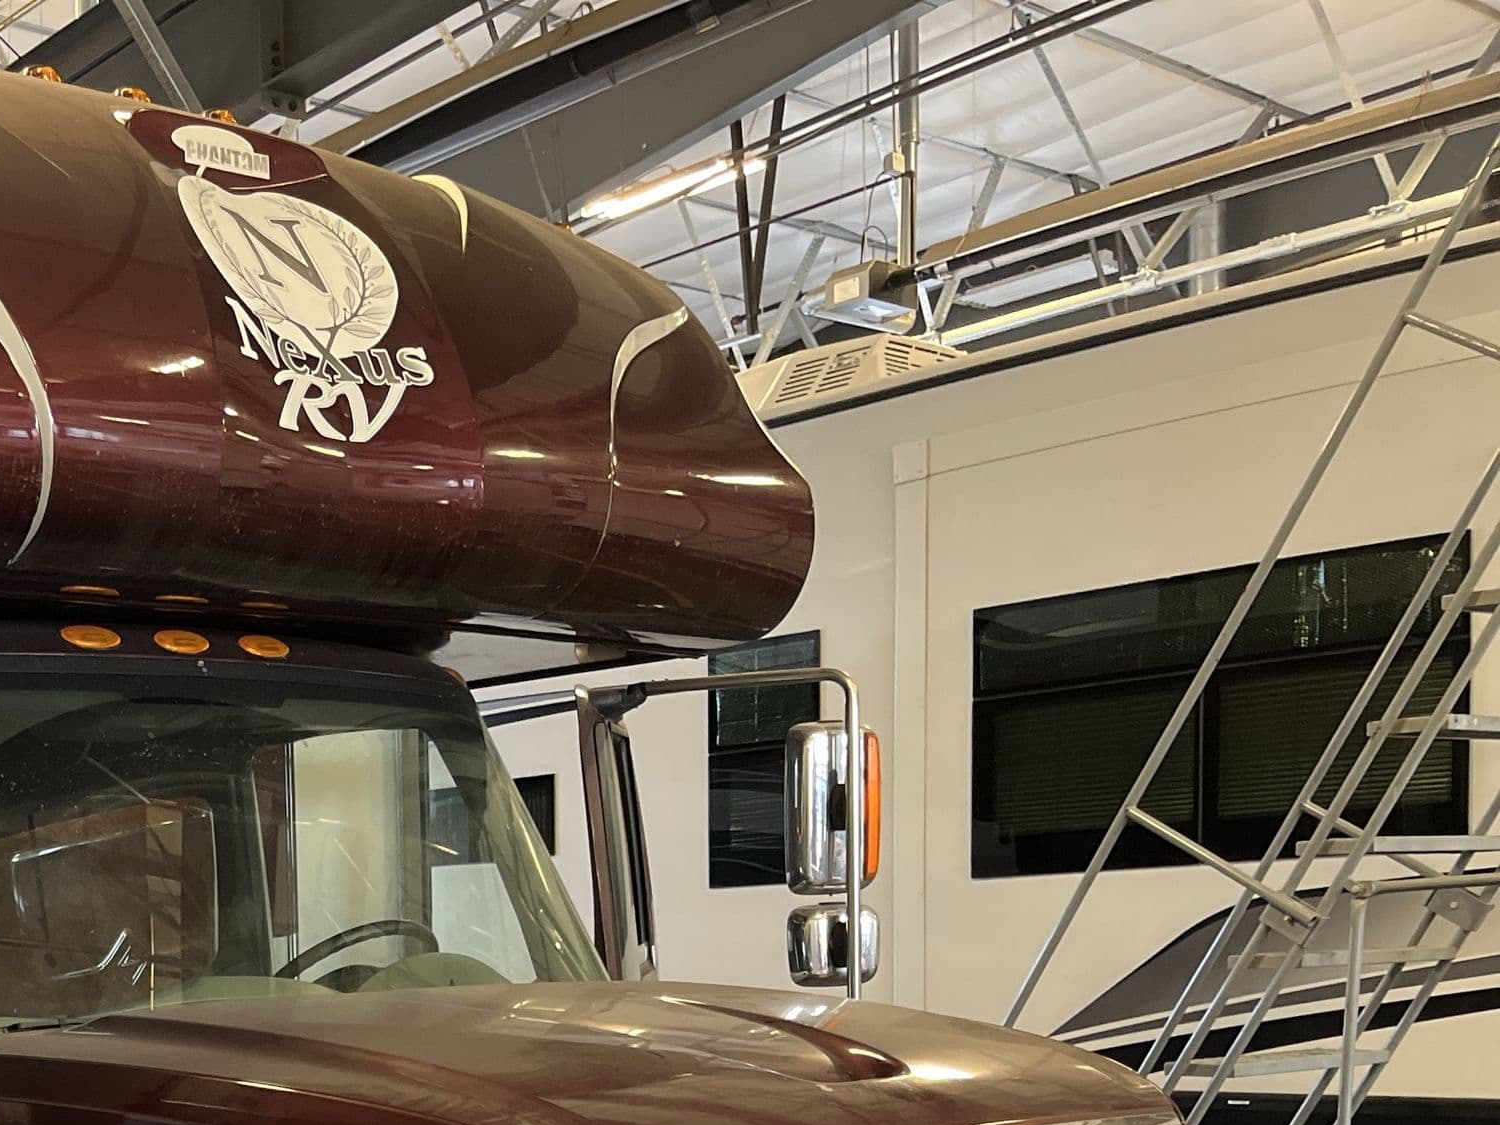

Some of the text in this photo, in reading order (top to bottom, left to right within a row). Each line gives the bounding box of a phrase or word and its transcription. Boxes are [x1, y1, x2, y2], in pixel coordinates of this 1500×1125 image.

[185, 140, 268, 173] PHANTOM
[219, 205, 329, 294] N
[273, 369, 408, 443] RV
